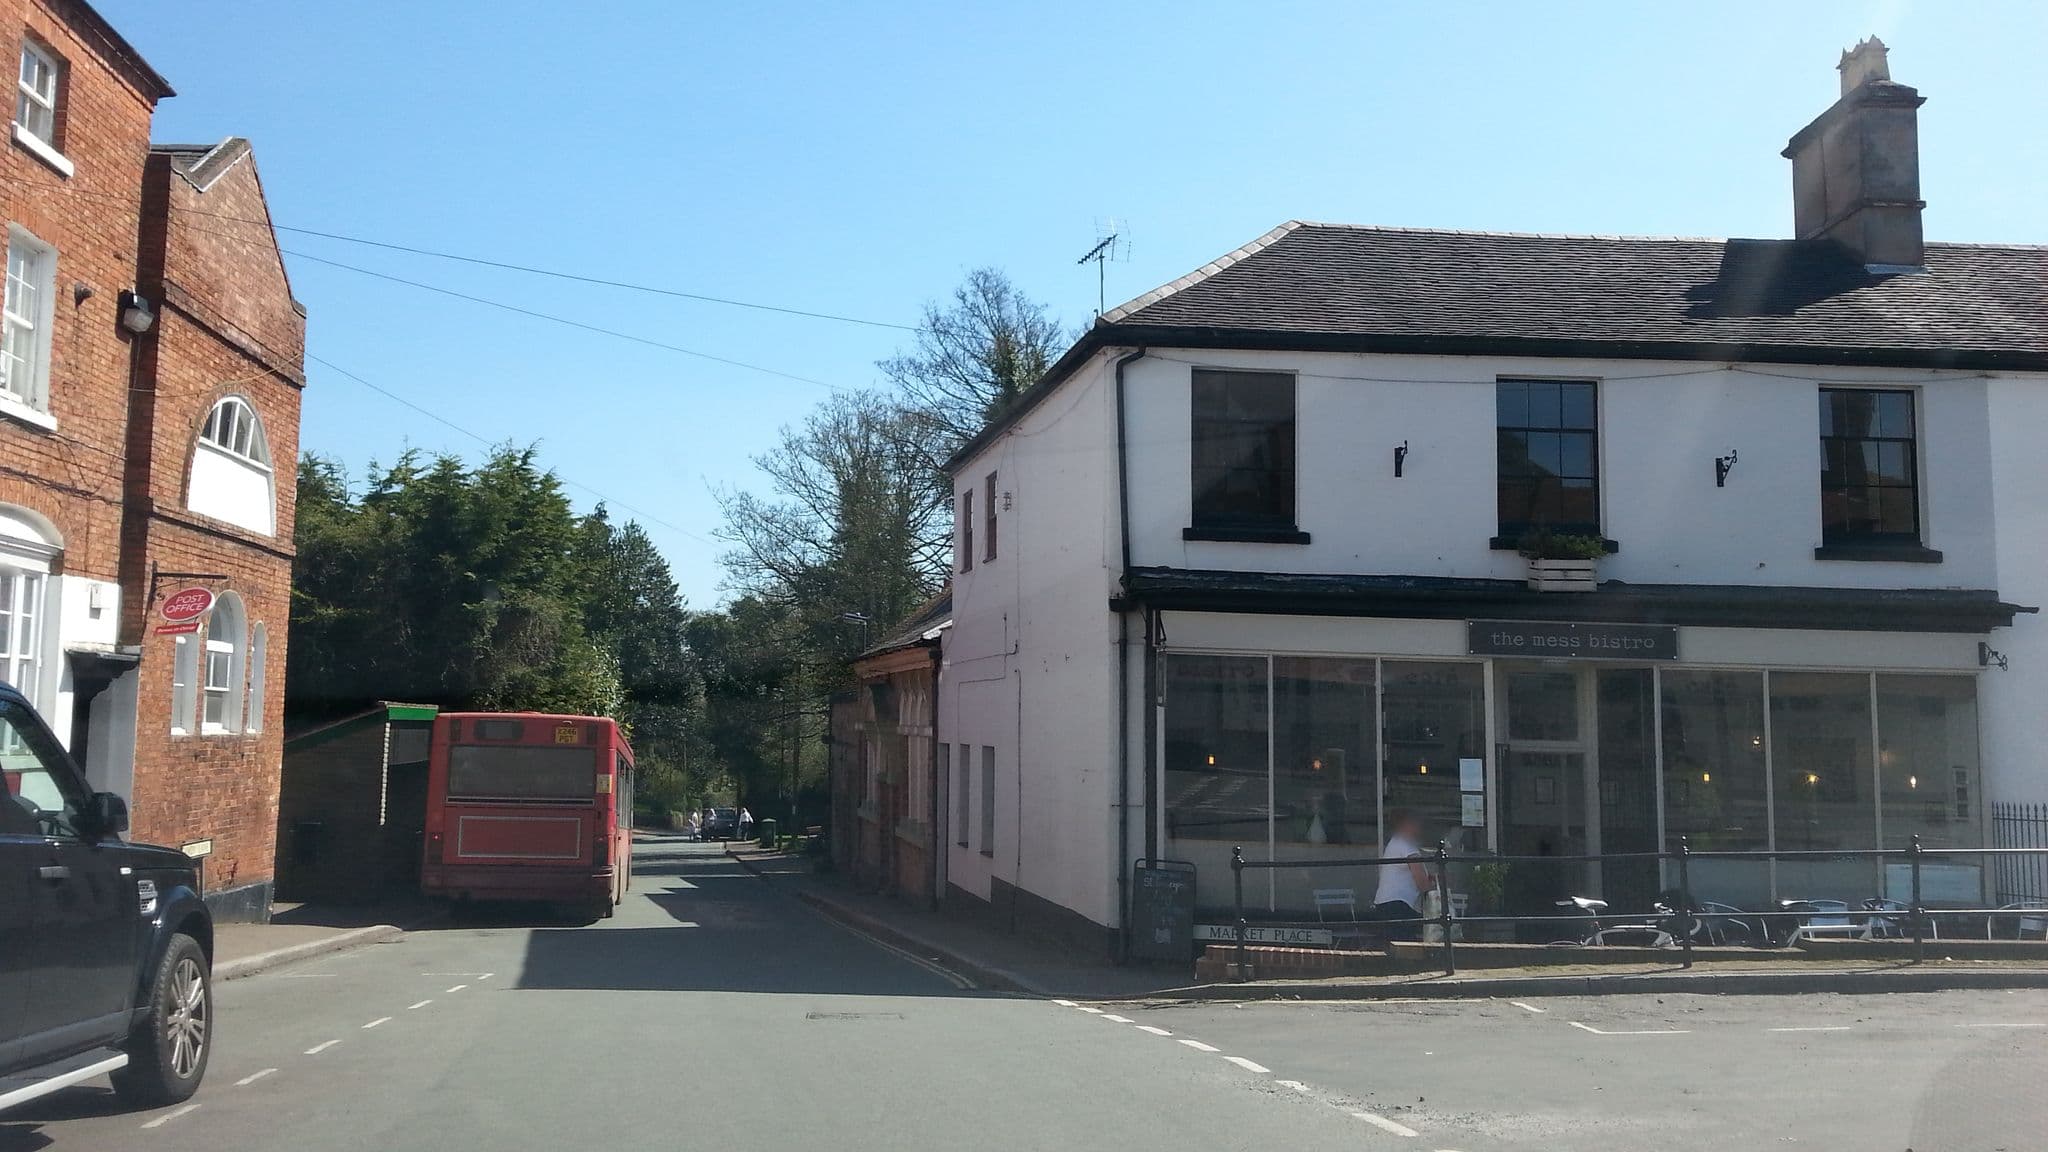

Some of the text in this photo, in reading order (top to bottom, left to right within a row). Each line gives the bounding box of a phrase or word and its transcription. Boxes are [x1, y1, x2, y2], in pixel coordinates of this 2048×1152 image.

[176, 594, 205, 604] POST
[166, 602, 205, 614] OFFICE
[1491, 631, 1656, 649] the mess bistro
[1274, 929, 1313, 942] PLACE
